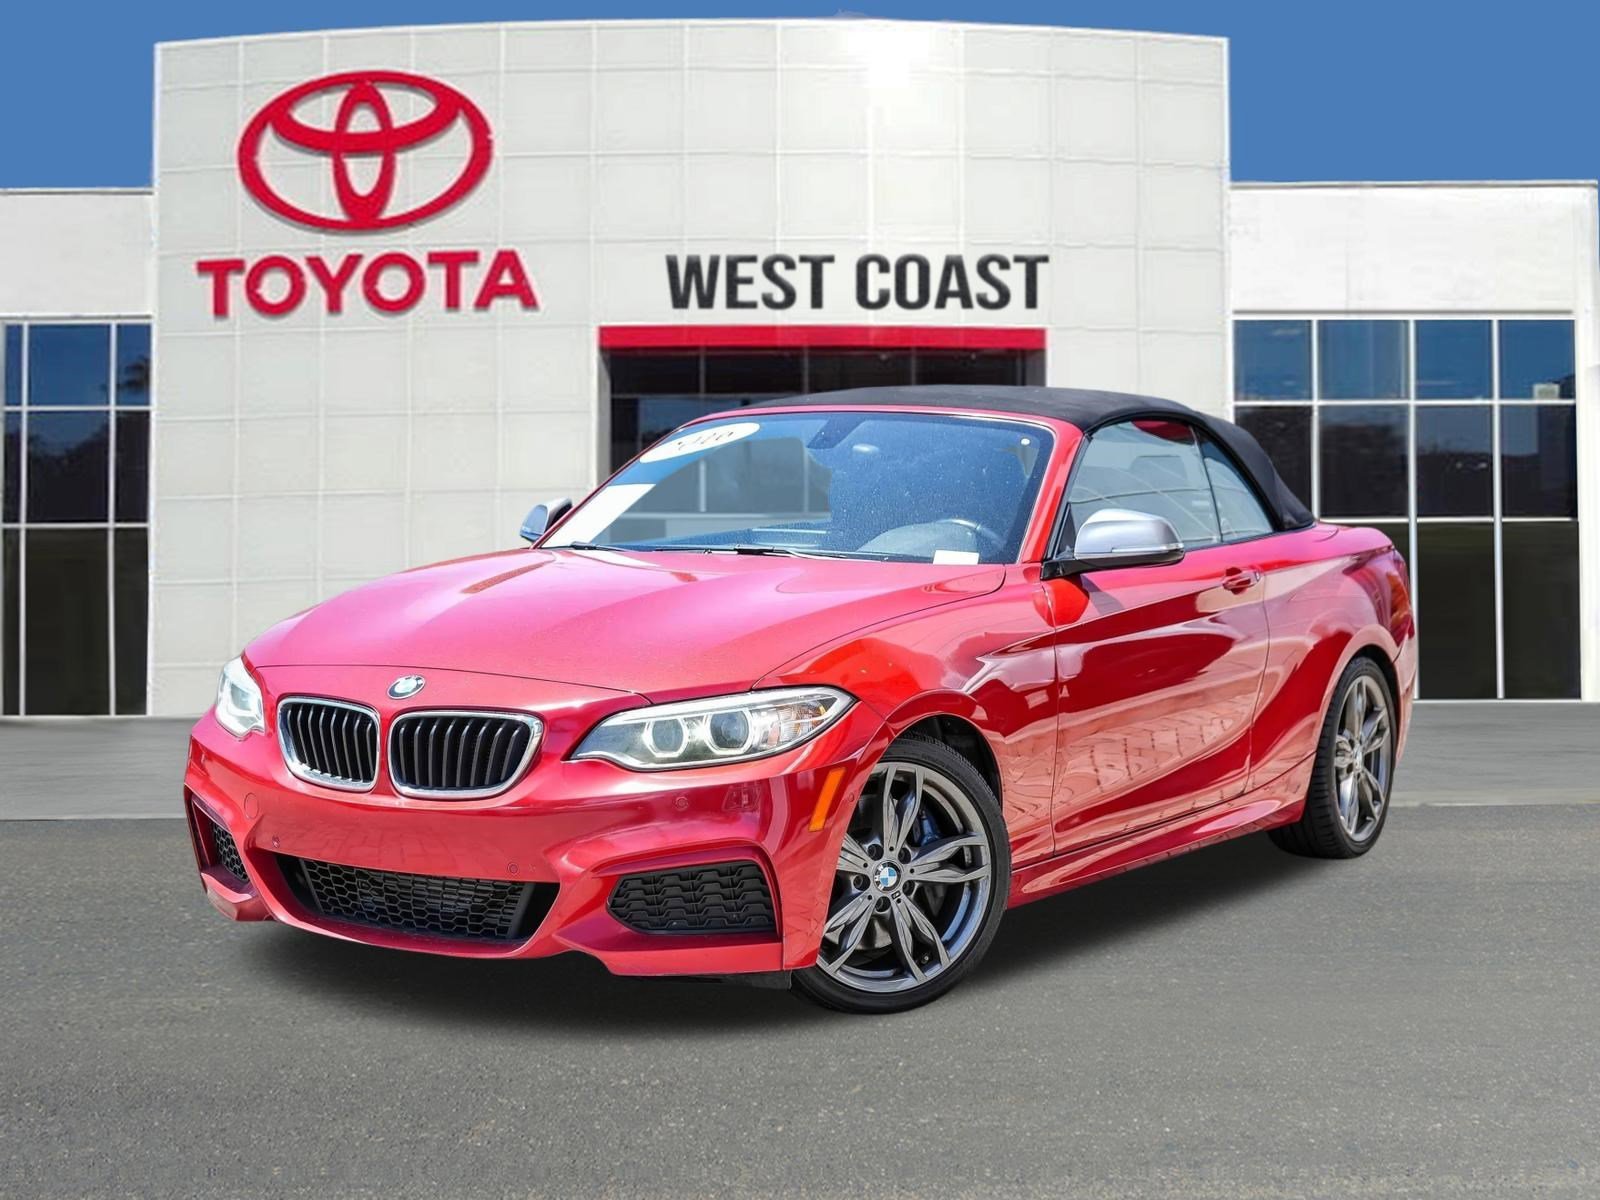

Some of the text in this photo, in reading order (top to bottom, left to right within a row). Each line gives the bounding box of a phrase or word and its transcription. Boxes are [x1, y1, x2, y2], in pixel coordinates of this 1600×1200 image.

[196, 250, 539, 317] TOYOTA
[665, 253, 1050, 310] WEST COAST
